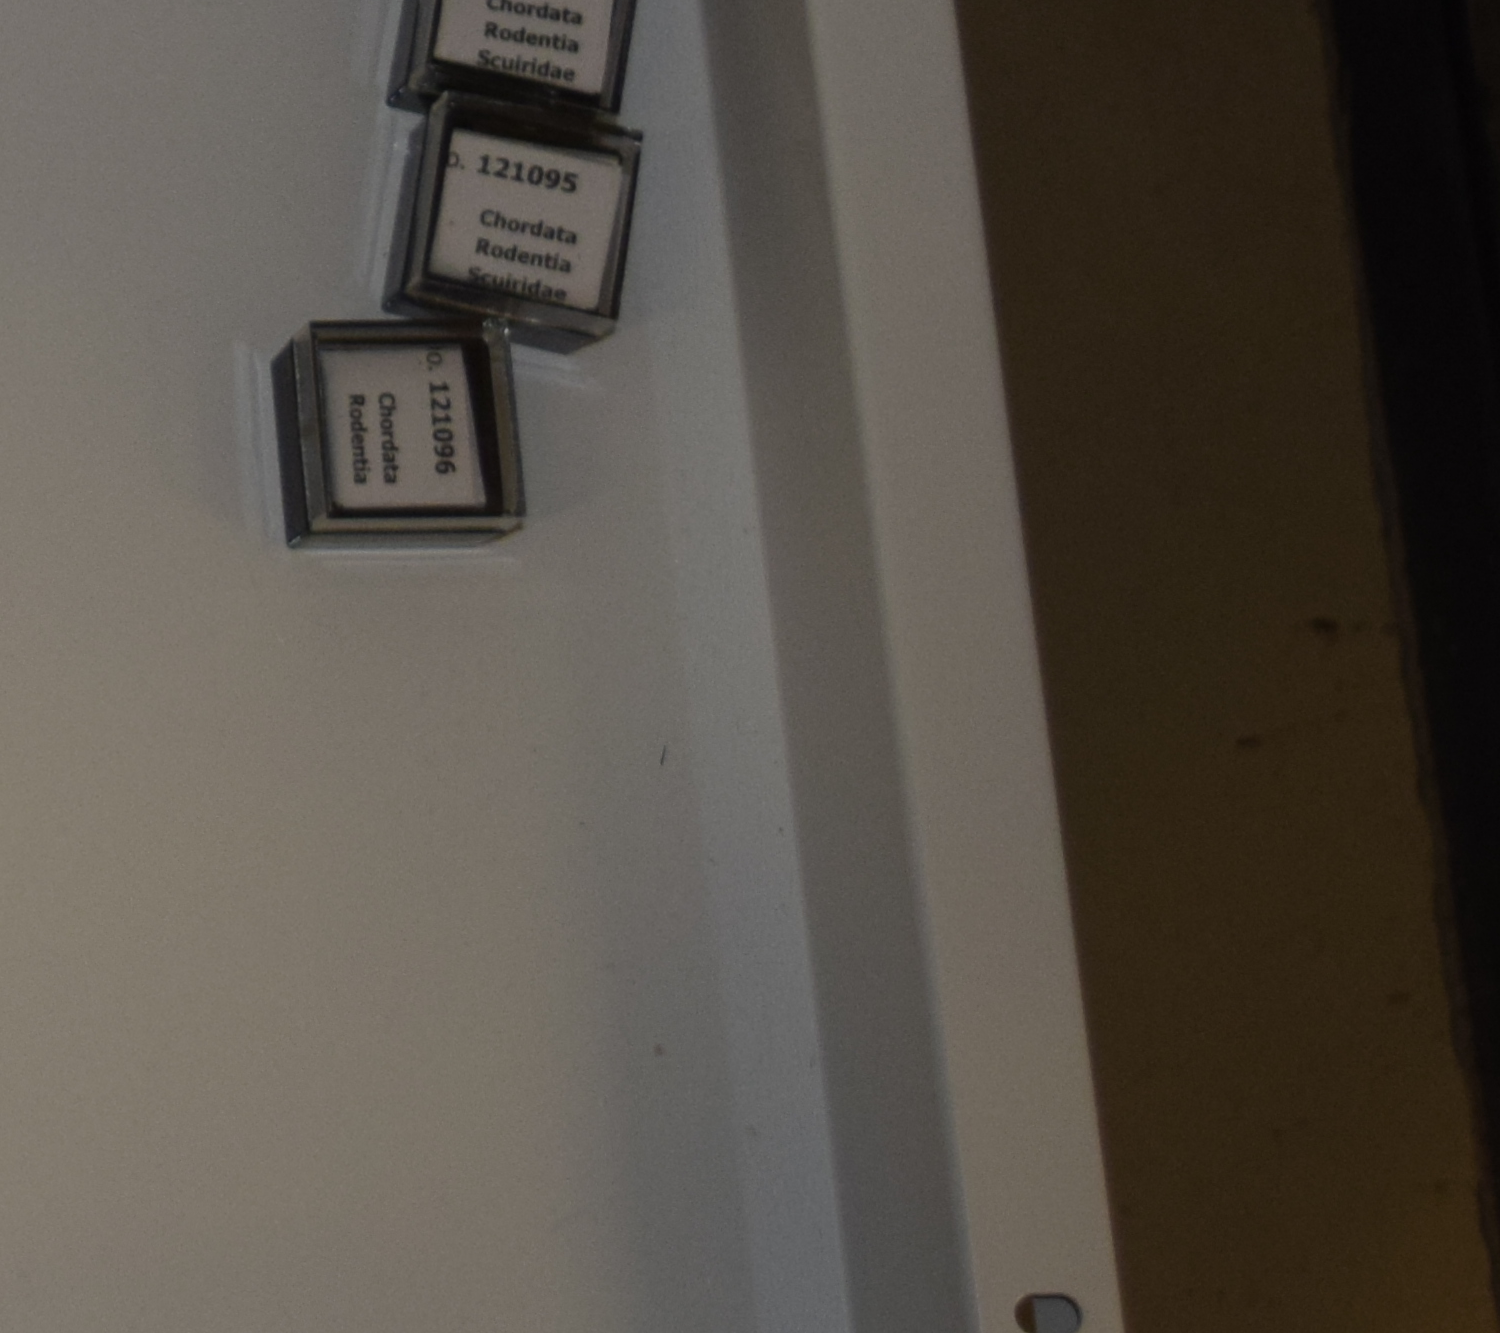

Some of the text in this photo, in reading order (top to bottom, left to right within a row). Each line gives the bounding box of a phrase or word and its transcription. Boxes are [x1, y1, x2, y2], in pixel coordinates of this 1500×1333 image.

[478, 154, 578, 193] 121095
[349, 394, 370, 485] Rodentia
[378, 392, 399, 485] Chordata
[429, 382, 456, 474] 121096
